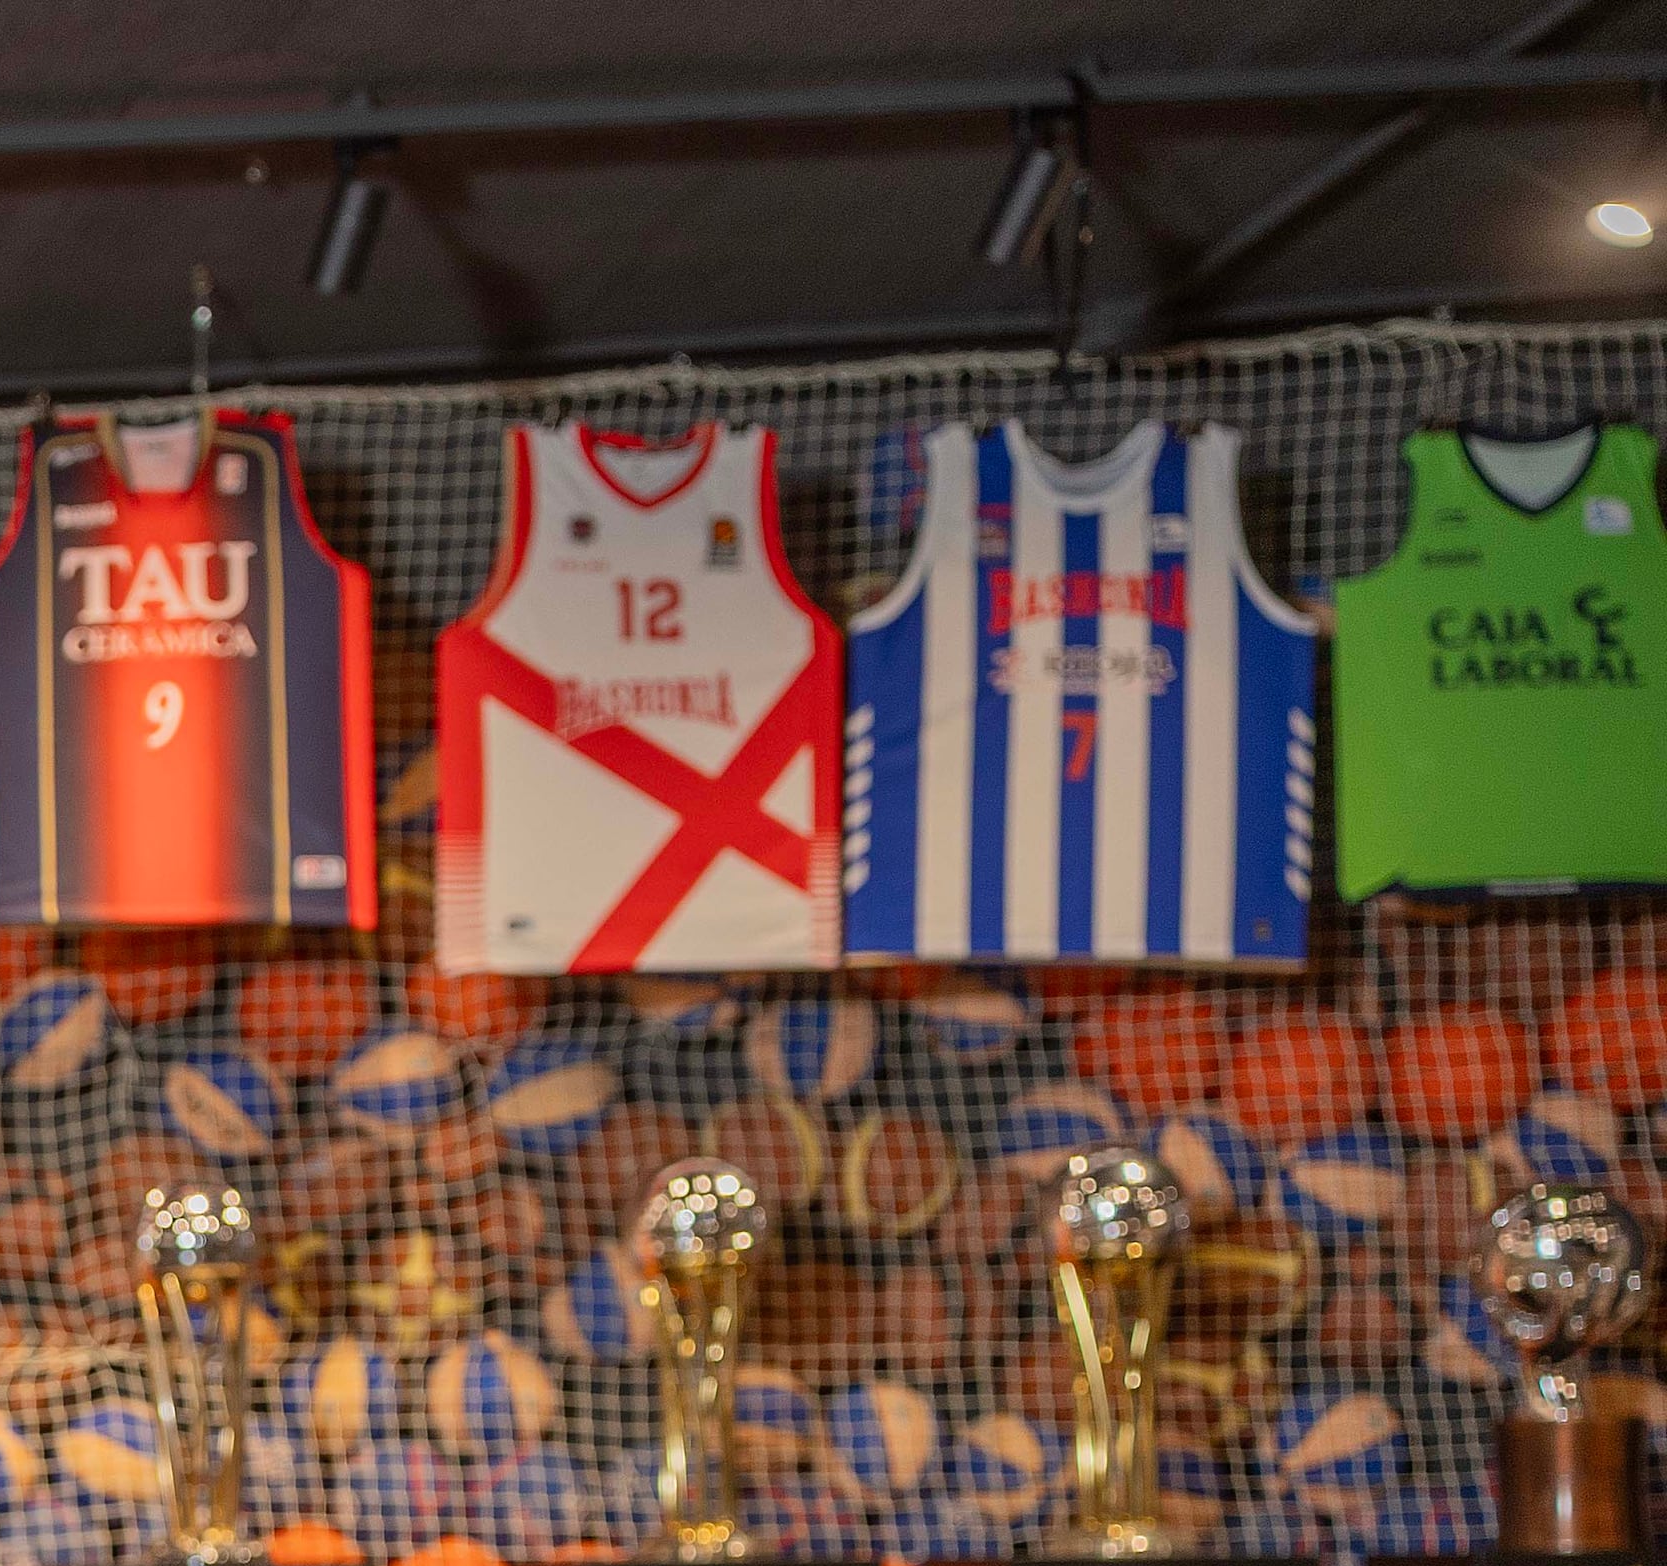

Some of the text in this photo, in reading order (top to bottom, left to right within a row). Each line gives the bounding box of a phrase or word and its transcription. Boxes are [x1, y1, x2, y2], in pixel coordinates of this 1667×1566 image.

[57, 540, 258, 625] TAU
[614, 575, 684, 642] 12
[144, 680, 184, 750] 9
[1063, 710, 1098, 782] 7
